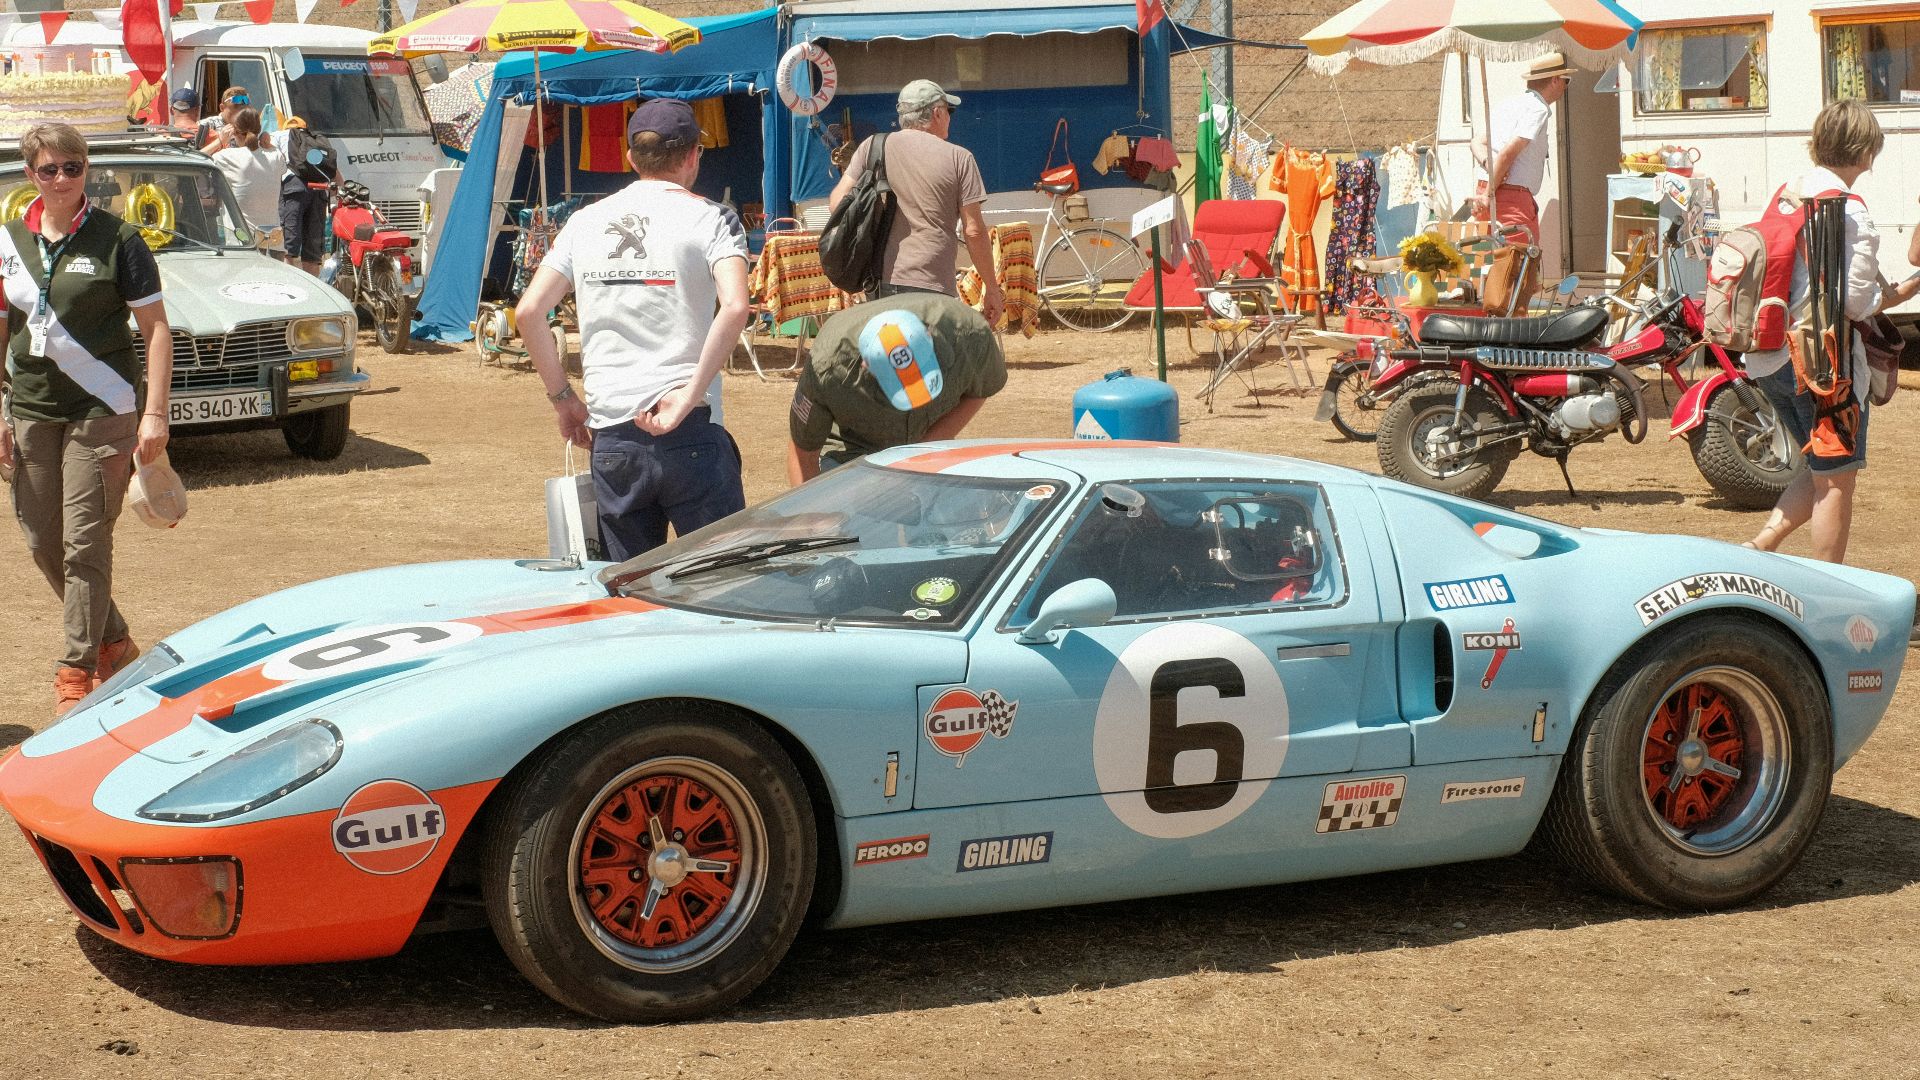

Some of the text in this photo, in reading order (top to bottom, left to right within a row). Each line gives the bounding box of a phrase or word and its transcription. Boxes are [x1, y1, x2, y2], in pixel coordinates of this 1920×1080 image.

[323, 61, 368, 71] PEUGEOT
[816, 57, 836, 102] FINA
[347, 151, 401, 165] PEUGEOT
[583, 270, 677, 280] PEUGEOT SPORT
[1429, 577, 1510, 610] GIRLING
[1640, 575, 1802, 621] S.E.V. MARCHAL
[288, 626, 452, 671] 6
[1465, 634, 1520, 649] KONI
[1848, 675, 1882, 689] FERODO
[928, 711, 988, 734] Gulf
[1143, 656, 1246, 814] 6
[1334, 781, 1395, 802] Autolite
[1445, 782, 1522, 800] Firestone
[336, 810, 441, 849] Gulf
[857, 840, 927, 861] FERODO
[963, 835, 1048, 869] GIRLING
